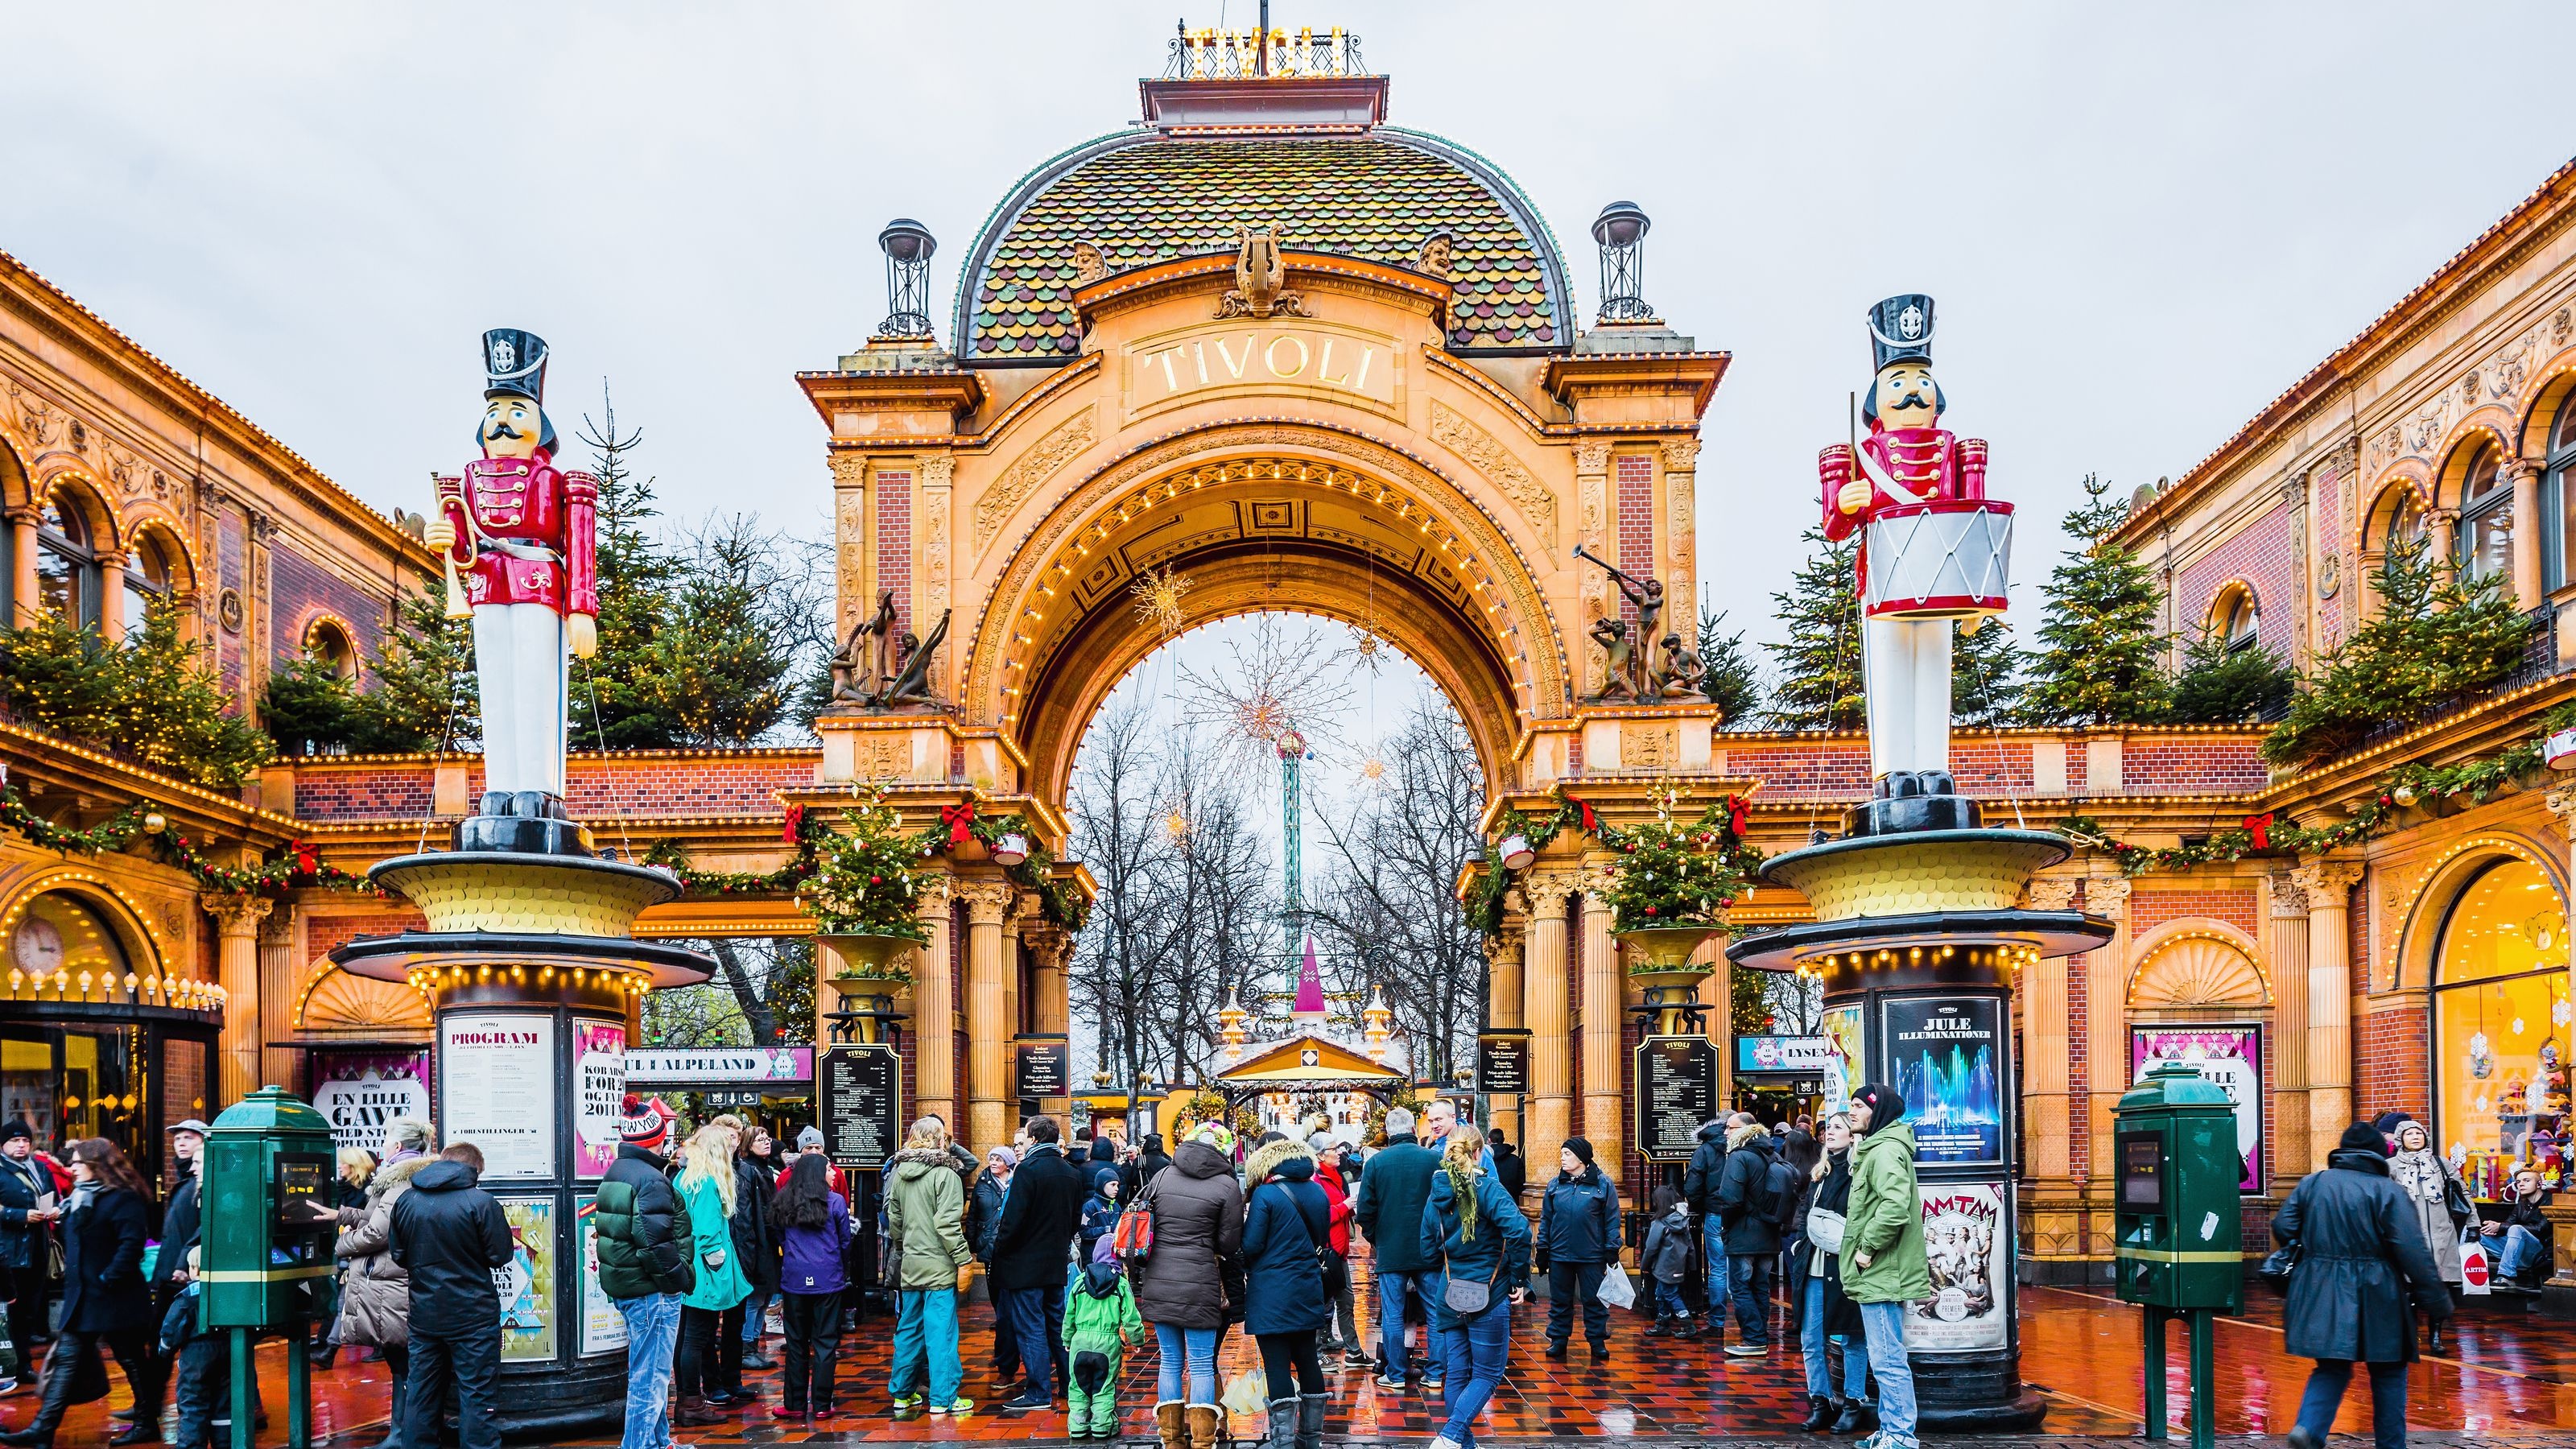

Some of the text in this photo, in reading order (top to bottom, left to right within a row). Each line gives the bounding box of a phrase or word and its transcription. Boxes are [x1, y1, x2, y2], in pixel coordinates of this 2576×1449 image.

[1184, 26, 1343, 77] TIVOLI
[1144, 333, 1373, 392] TIVOLI
[1923, 1018, 1971, 1030] JULE
[452, 1032, 538, 1045] PROGRAM
[1898, 1030, 1991, 1040] ILLUMINATIONER
[650, 1059, 656, 1071] I
[663, 1059, 756, 1071] ALPELAND
[332, 1093, 411, 1105] EN LILLE
[585, 1092, 602, 1102] OG
[585, 1103, 615, 1117] 2014
[332, 1107, 411, 1127] GAVE
[638, 1113, 659, 1131] YORK
